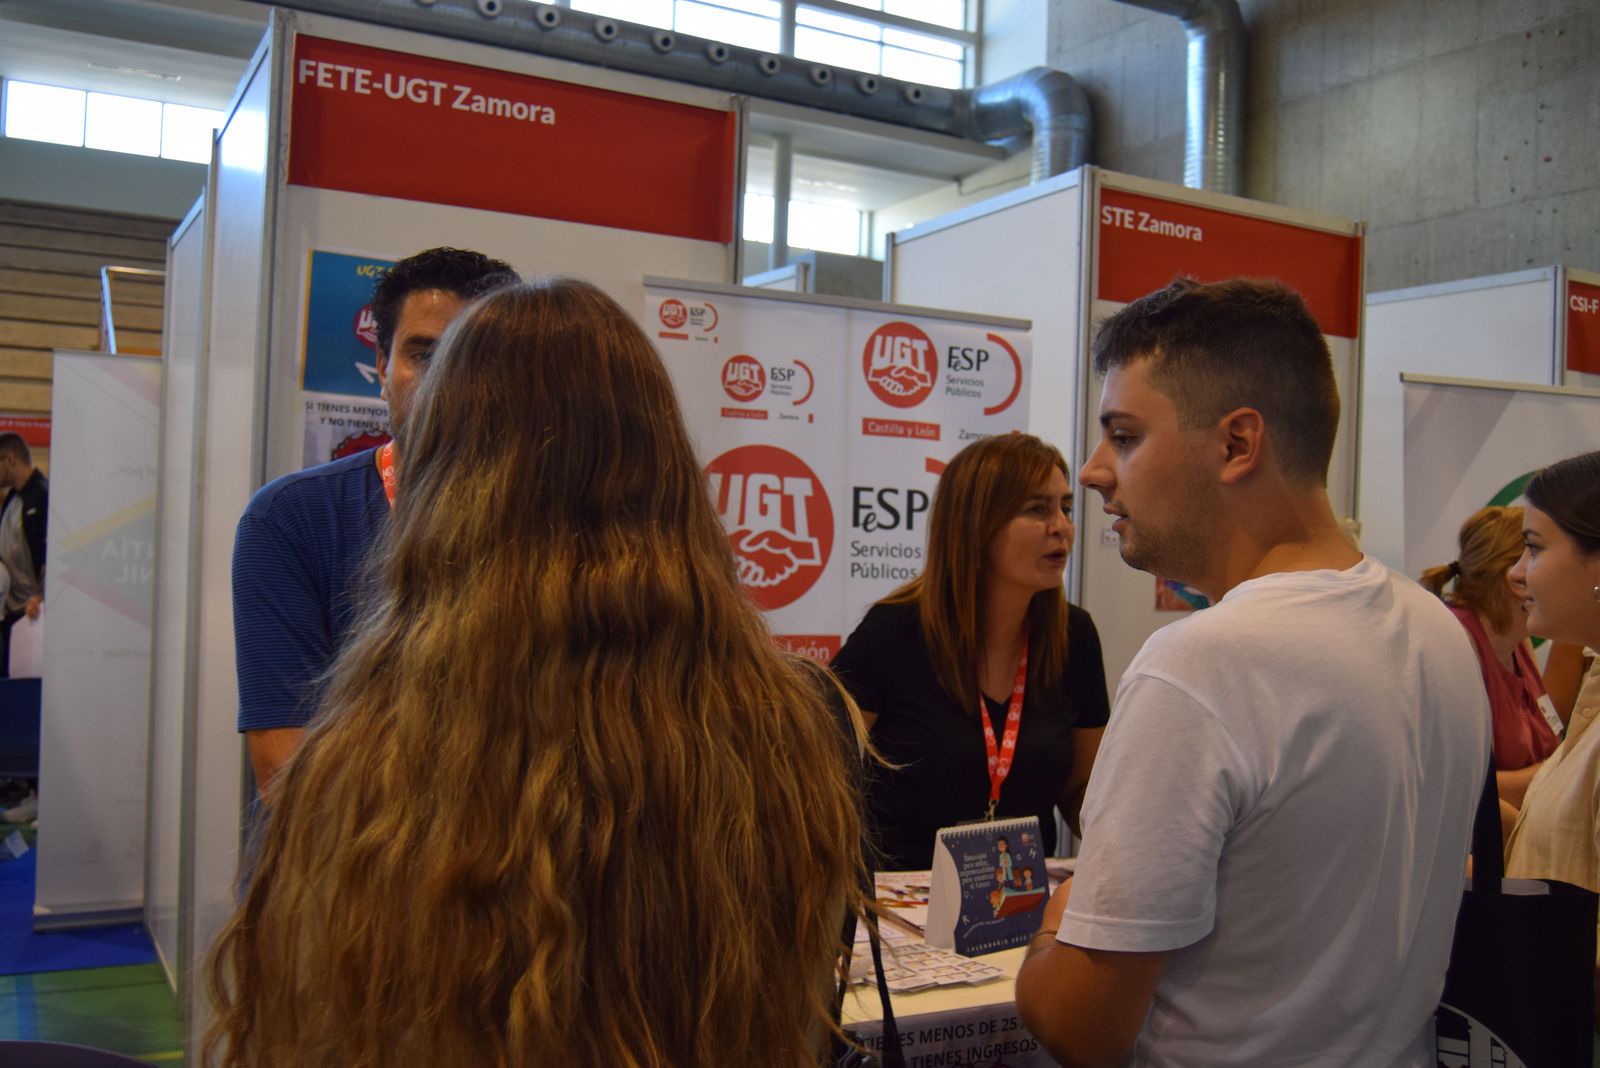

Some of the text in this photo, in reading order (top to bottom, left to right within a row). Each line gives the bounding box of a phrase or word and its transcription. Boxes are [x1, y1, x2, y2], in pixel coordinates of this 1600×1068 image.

[299, 59, 556, 125] FETE-UGT Zamora
[1101, 205, 1203, 241] STE Zamora
[871, 335, 930, 373] UGT
[726, 362, 761, 384] UGT
[945, 375, 984, 387] Servicios
[945, 387, 982, 398] Públicos
[868, 422, 935, 437] Castilla y León
[708, 473, 815, 540] UGT
[851, 541, 922, 559] Servicios
[851, 562, 918, 580] Públicos
[919, 1021, 975, 1044] MENOS
[979, 1018, 997, 1034] DE
[1002, 1016, 1017, 1031] 25
[911, 1038, 1038, 1068] TIENES INGRESOS
